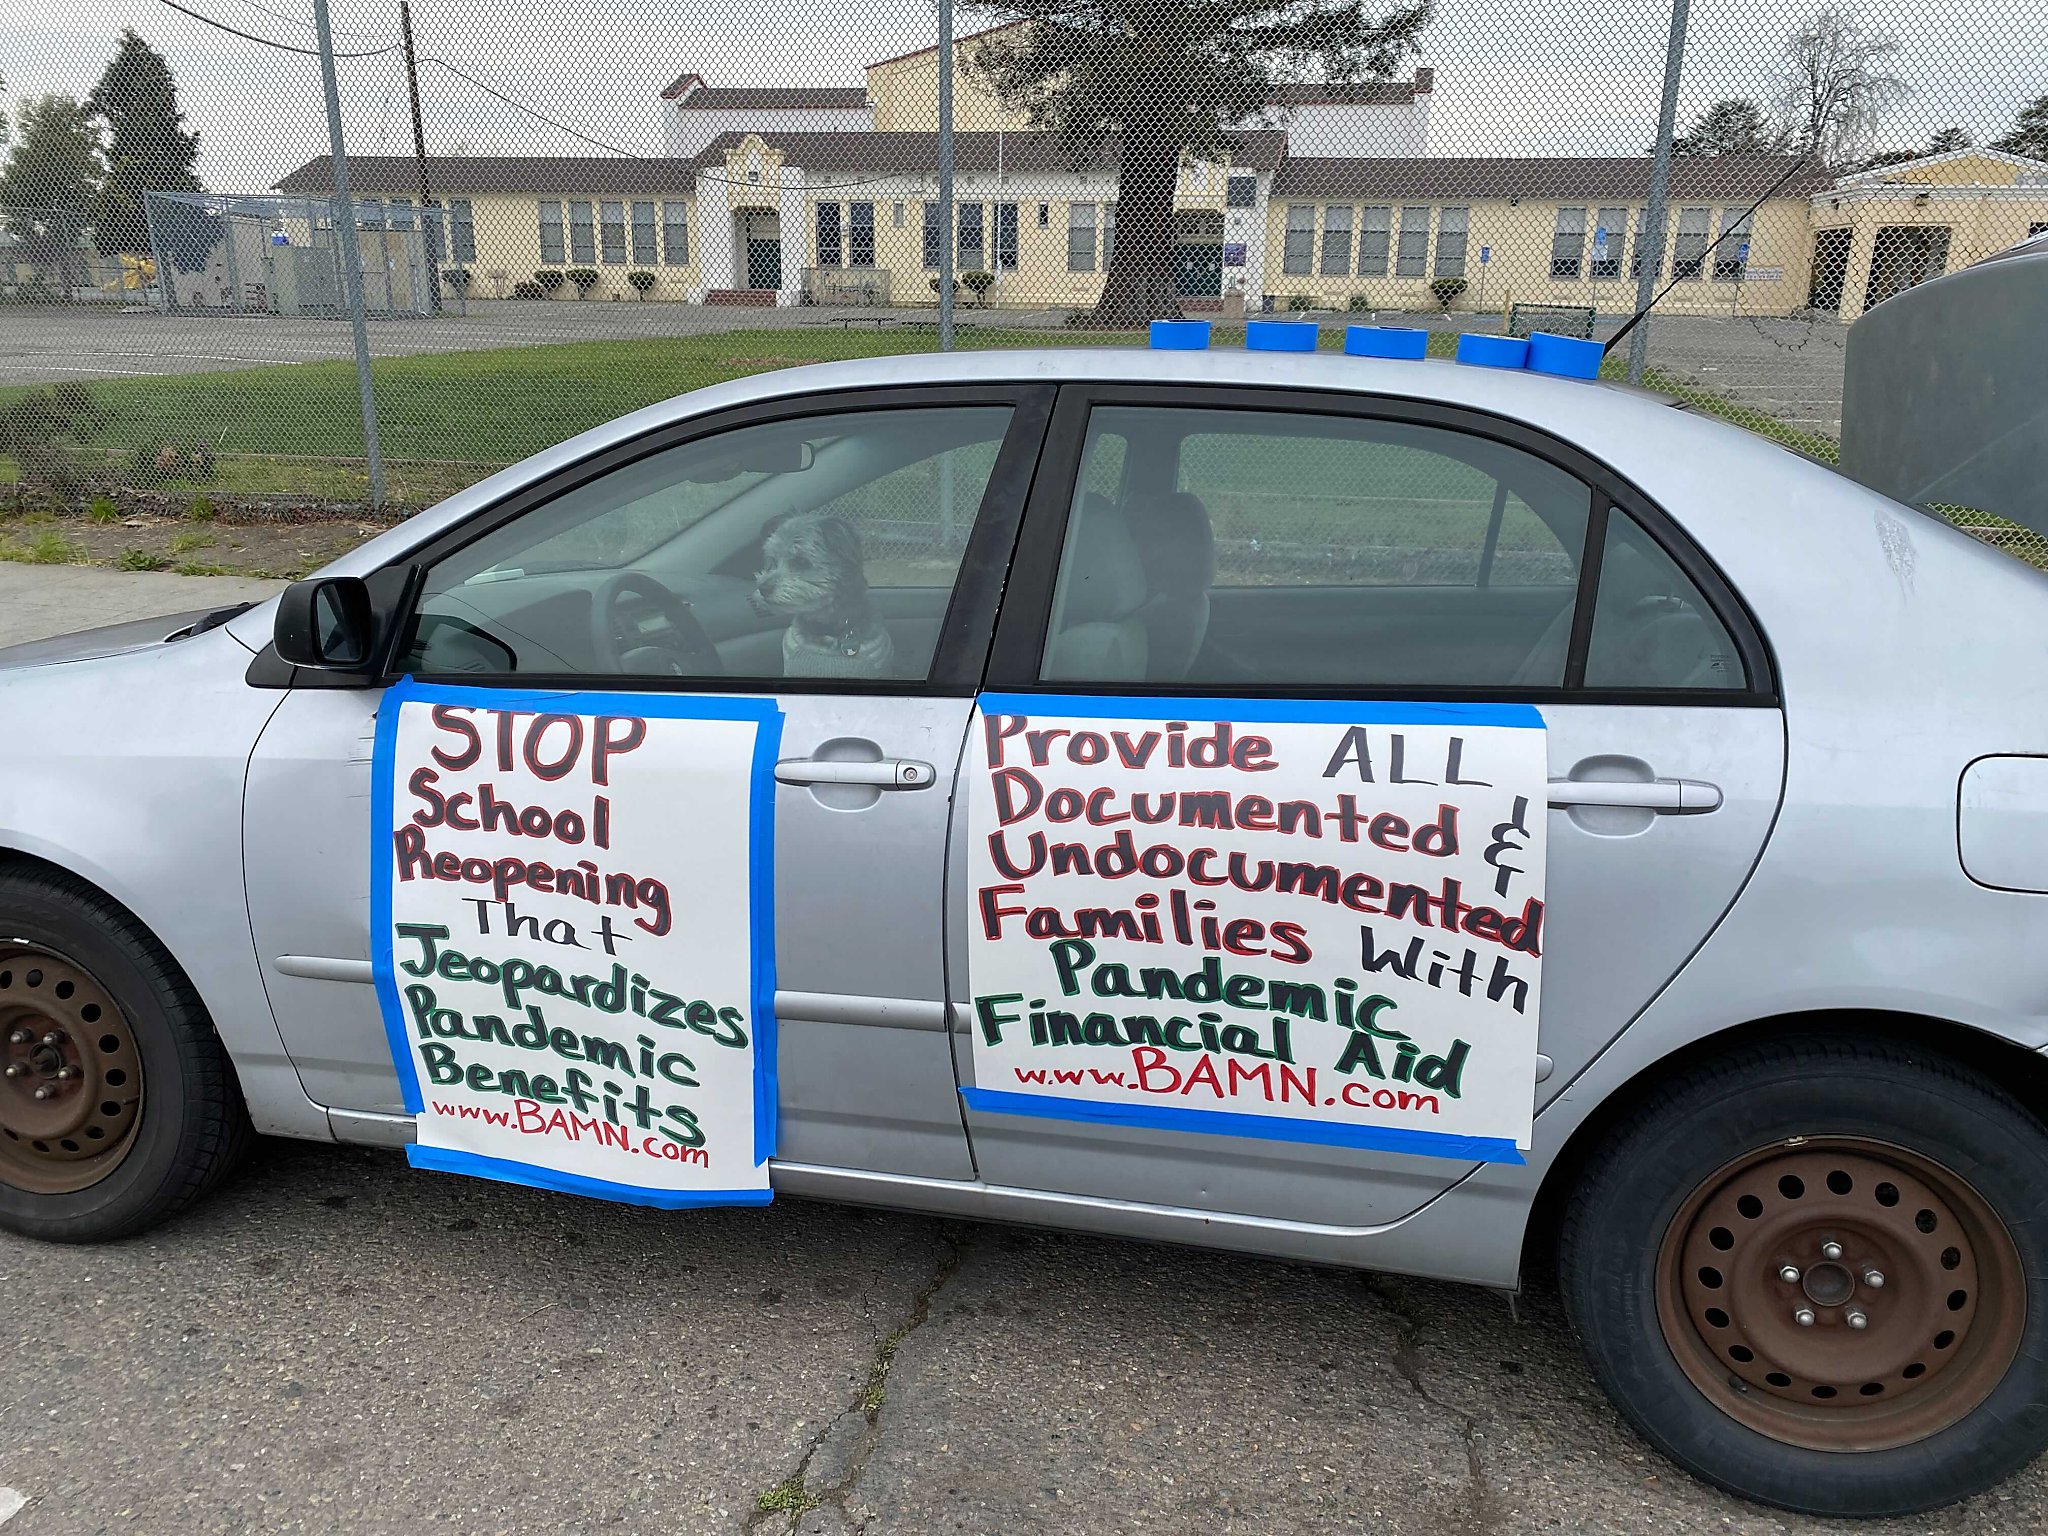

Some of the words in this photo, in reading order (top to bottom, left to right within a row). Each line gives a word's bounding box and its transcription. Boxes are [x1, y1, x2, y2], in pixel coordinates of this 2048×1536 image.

[431, 703, 647, 786] STOP
[982, 713, 1280, 770] Provide
[1322, 726, 1493, 787] ALL
[408, 767, 610, 851] School
[991, 767, 1460, 857] Documented
[1484, 796, 1530, 898] &
[393, 824, 673, 937] Reopening
[461, 898, 634, 956] That
[988, 829, 1546, 957] Undocumented
[395, 923, 750, 1050] Jeopardizes
[978, 884, 1313, 965] Families
[1360, 925, 1530, 1016] With
[1048, 938, 1411, 1042] Pandemic
[404, 983, 702, 1088] Pandemic
[974, 992, 1296, 1065] Financial
[1334, 1029, 1473, 1100] Aid
[417, 1042, 707, 1148] Benefits
